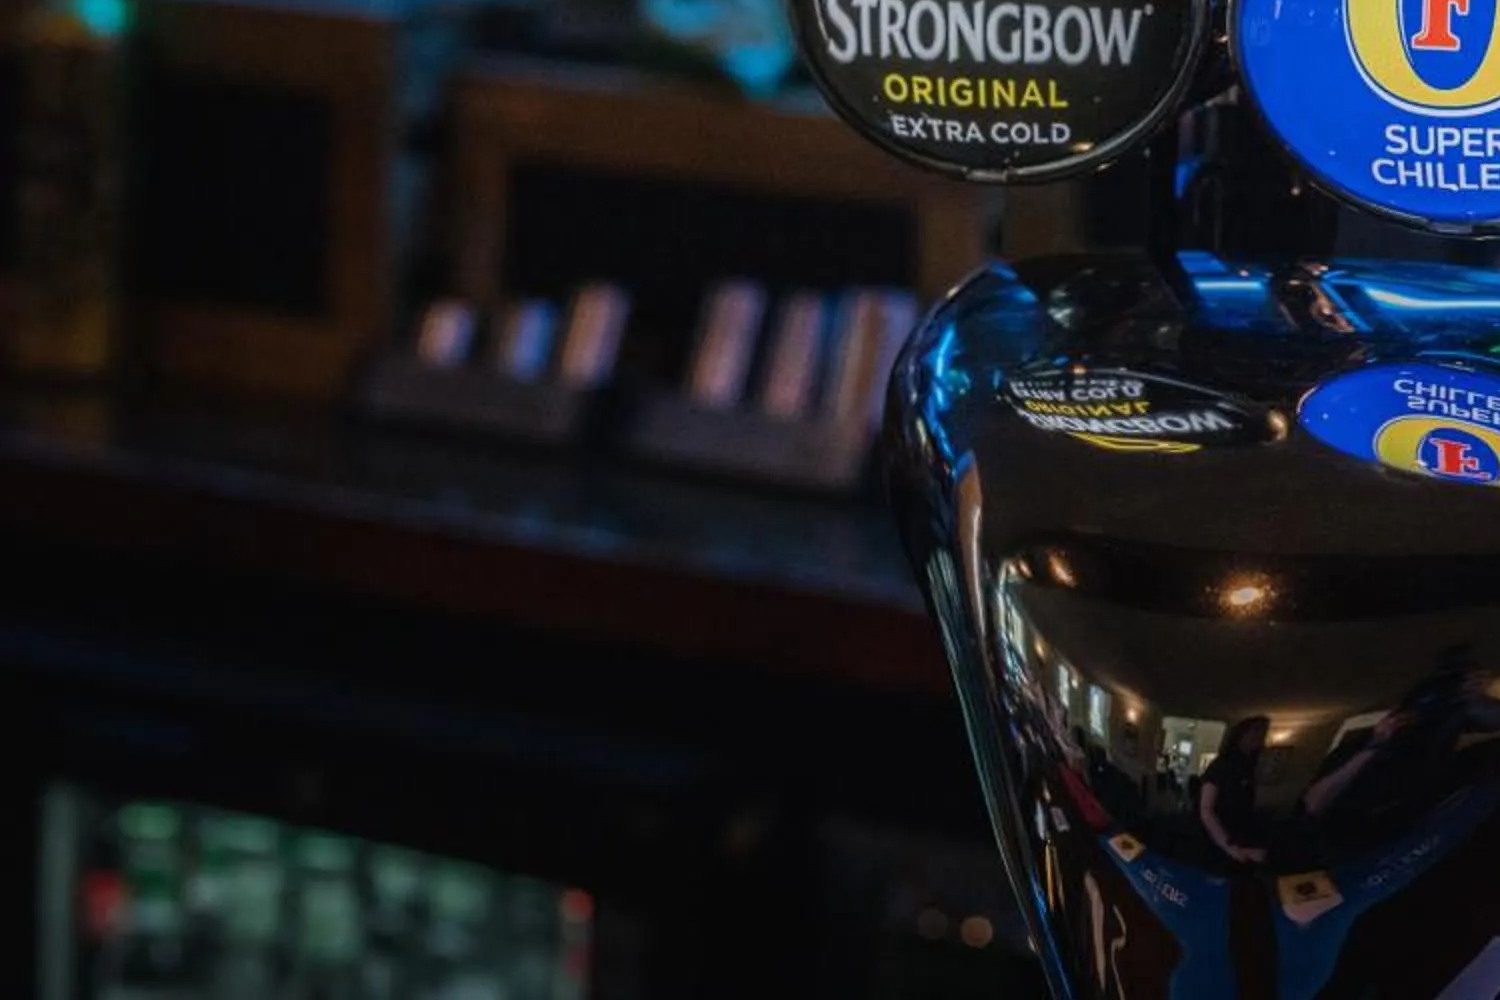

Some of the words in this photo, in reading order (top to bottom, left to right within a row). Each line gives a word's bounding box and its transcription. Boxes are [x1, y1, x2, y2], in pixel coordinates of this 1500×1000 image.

[883, 73, 1069, 109] ORIGINAL
[892, 115, 986, 144] EXTRA
[990, 121, 1071, 144] COLD
